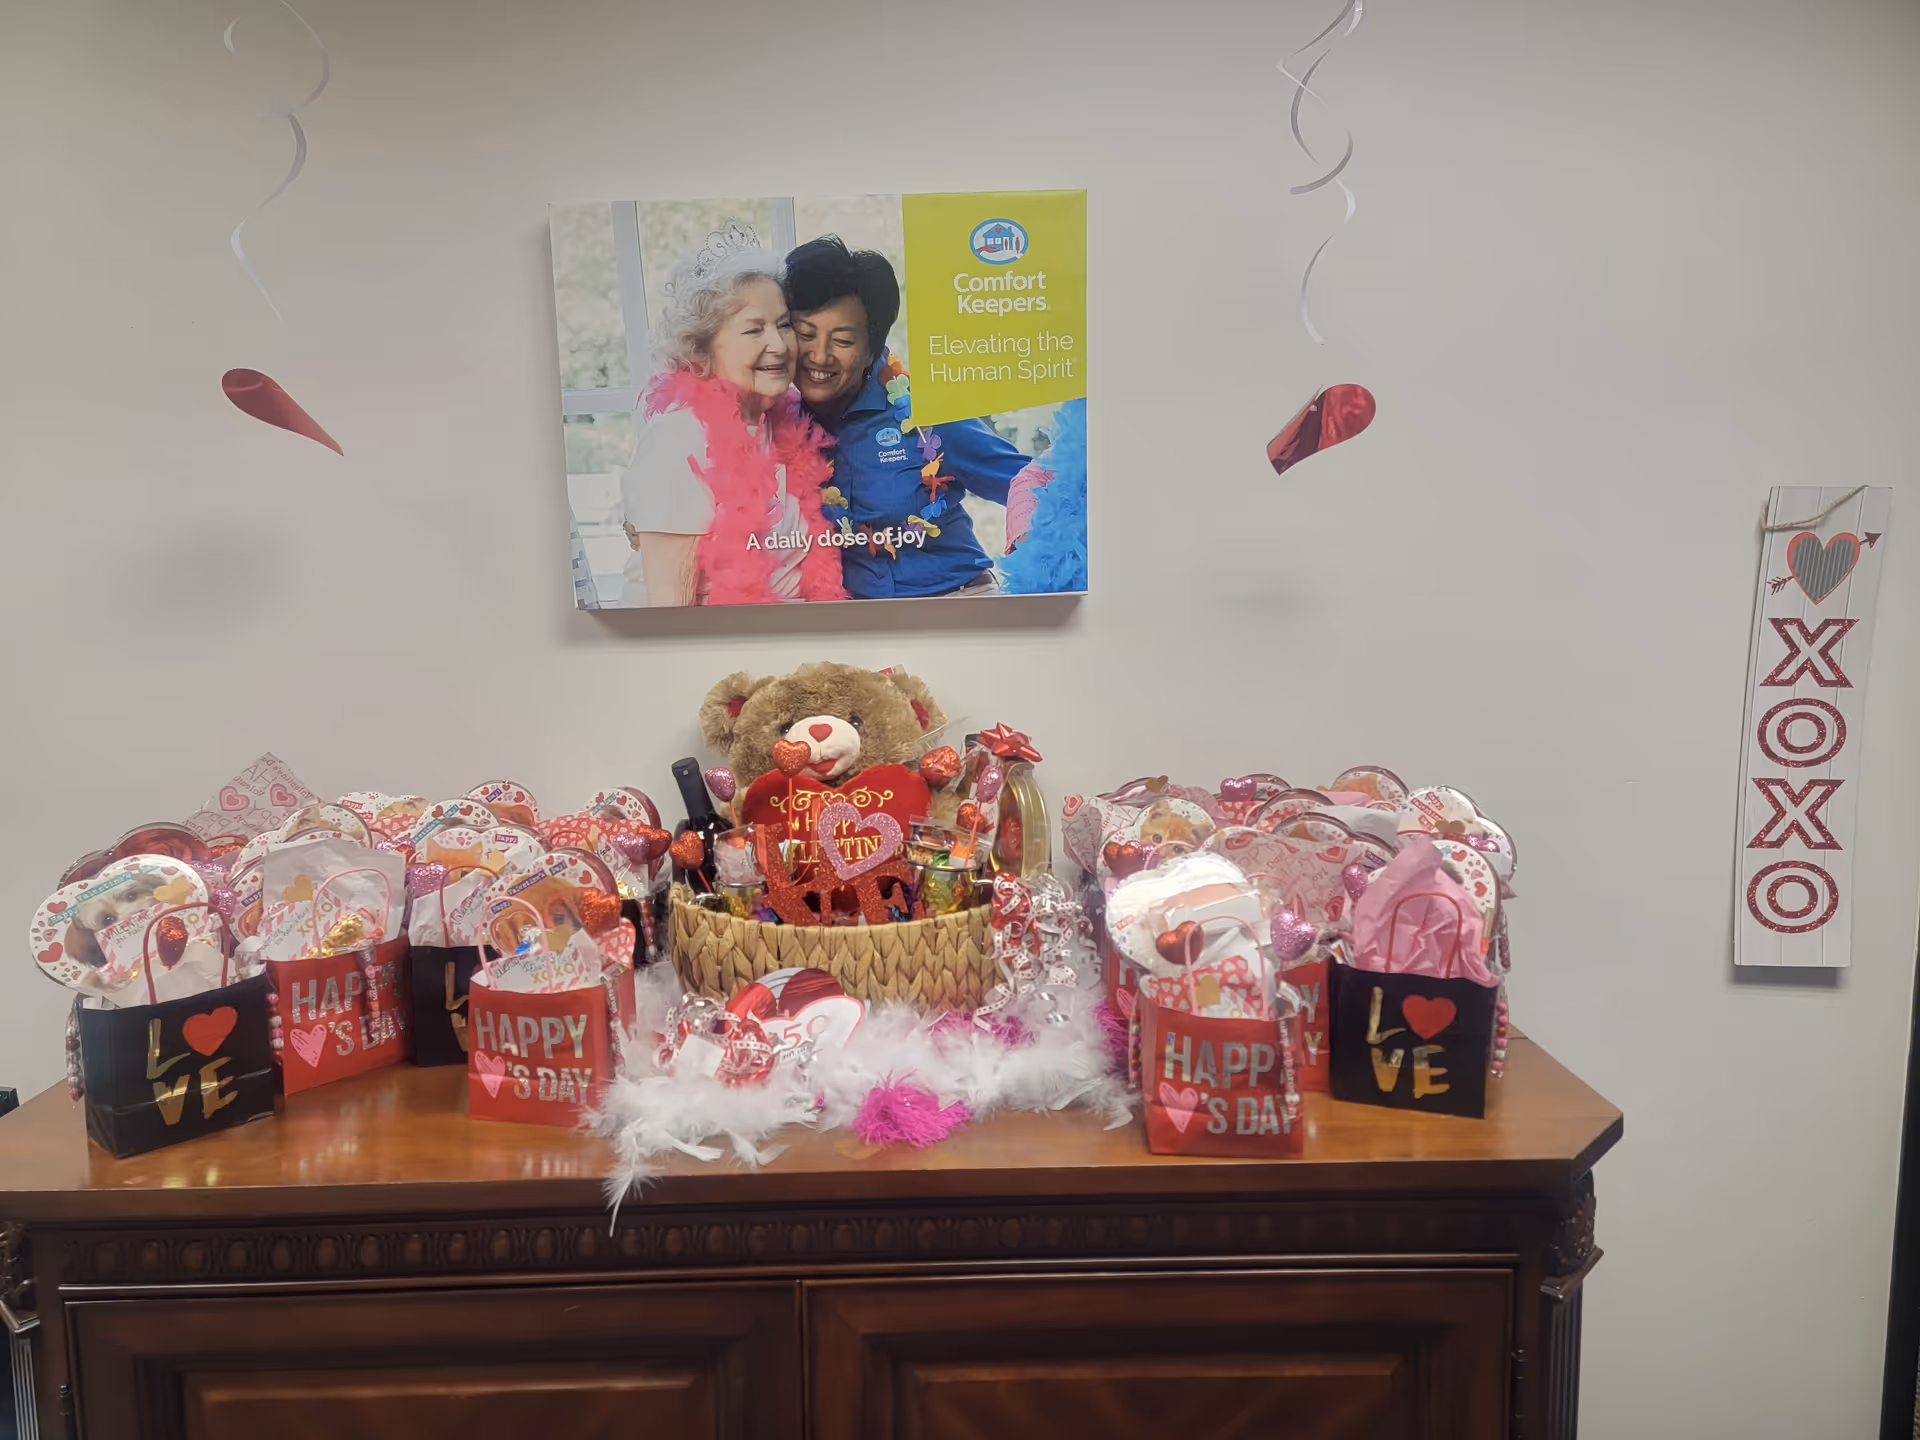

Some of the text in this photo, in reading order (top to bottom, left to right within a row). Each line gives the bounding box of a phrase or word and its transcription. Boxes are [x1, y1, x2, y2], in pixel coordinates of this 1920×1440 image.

[953, 271, 1047, 293] Comfort
[957, 294, 1048, 317] Keepers
[929, 330, 1074, 358] Elevating the
[930, 357, 1074, 385] Human Spirit
[878, 448, 906, 458] Comfort
[745, 527, 927, 552] A daily dose of joy
[507, 870, 547, 896] Valentine's
[474, 1007, 588, 1059] HAPPY
[1164, 1031, 1284, 1089] HAPP
[536, 1066, 592, 1105] DAY
